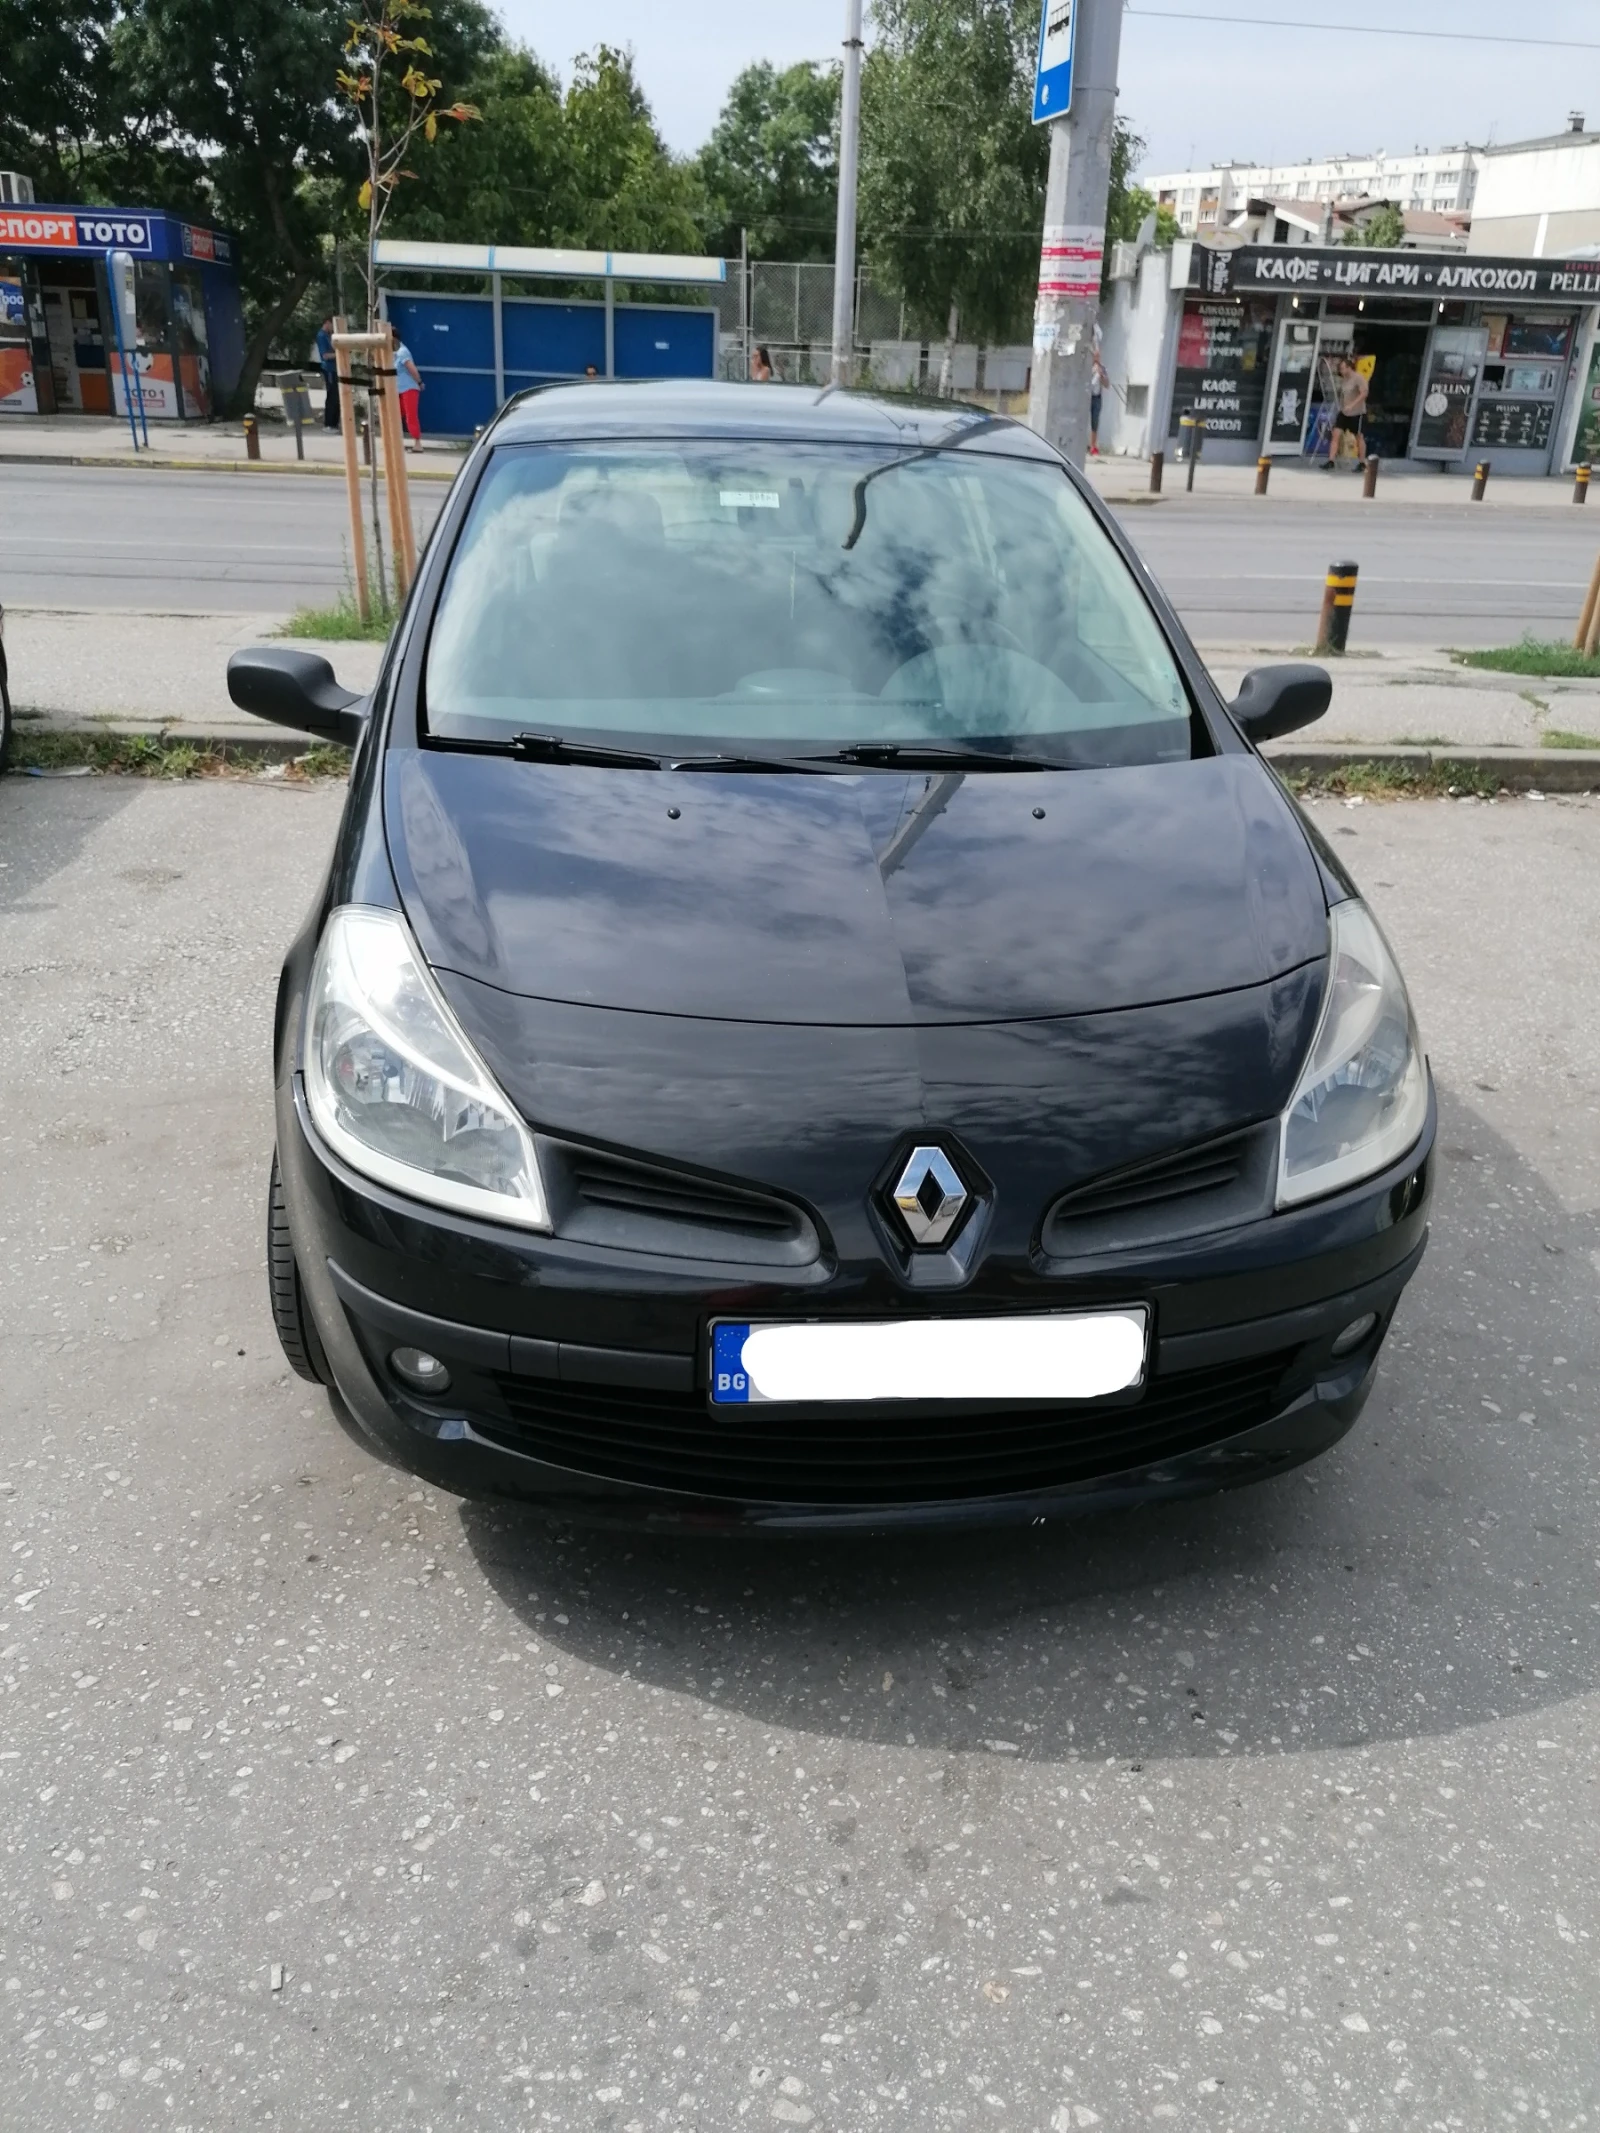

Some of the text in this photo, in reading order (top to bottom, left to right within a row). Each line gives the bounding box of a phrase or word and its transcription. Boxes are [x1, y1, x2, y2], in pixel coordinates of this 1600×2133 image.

[79, 221, 146, 244] ТОТО
[1256, 257, 1537, 291] КАФЕ ЦИГАРИ АЛКОХОЛ
[1202, 379, 1237, 393] КАФЕ
[1431, 383, 1471, 395] PELLINI
[123, 388, 158, 399] ОТО
[1194, 397, 1240, 411] ЦИГАРИ
[1205, 418, 1242, 431] КОХОЛ
[718, 1373, 746, 1391] BG
